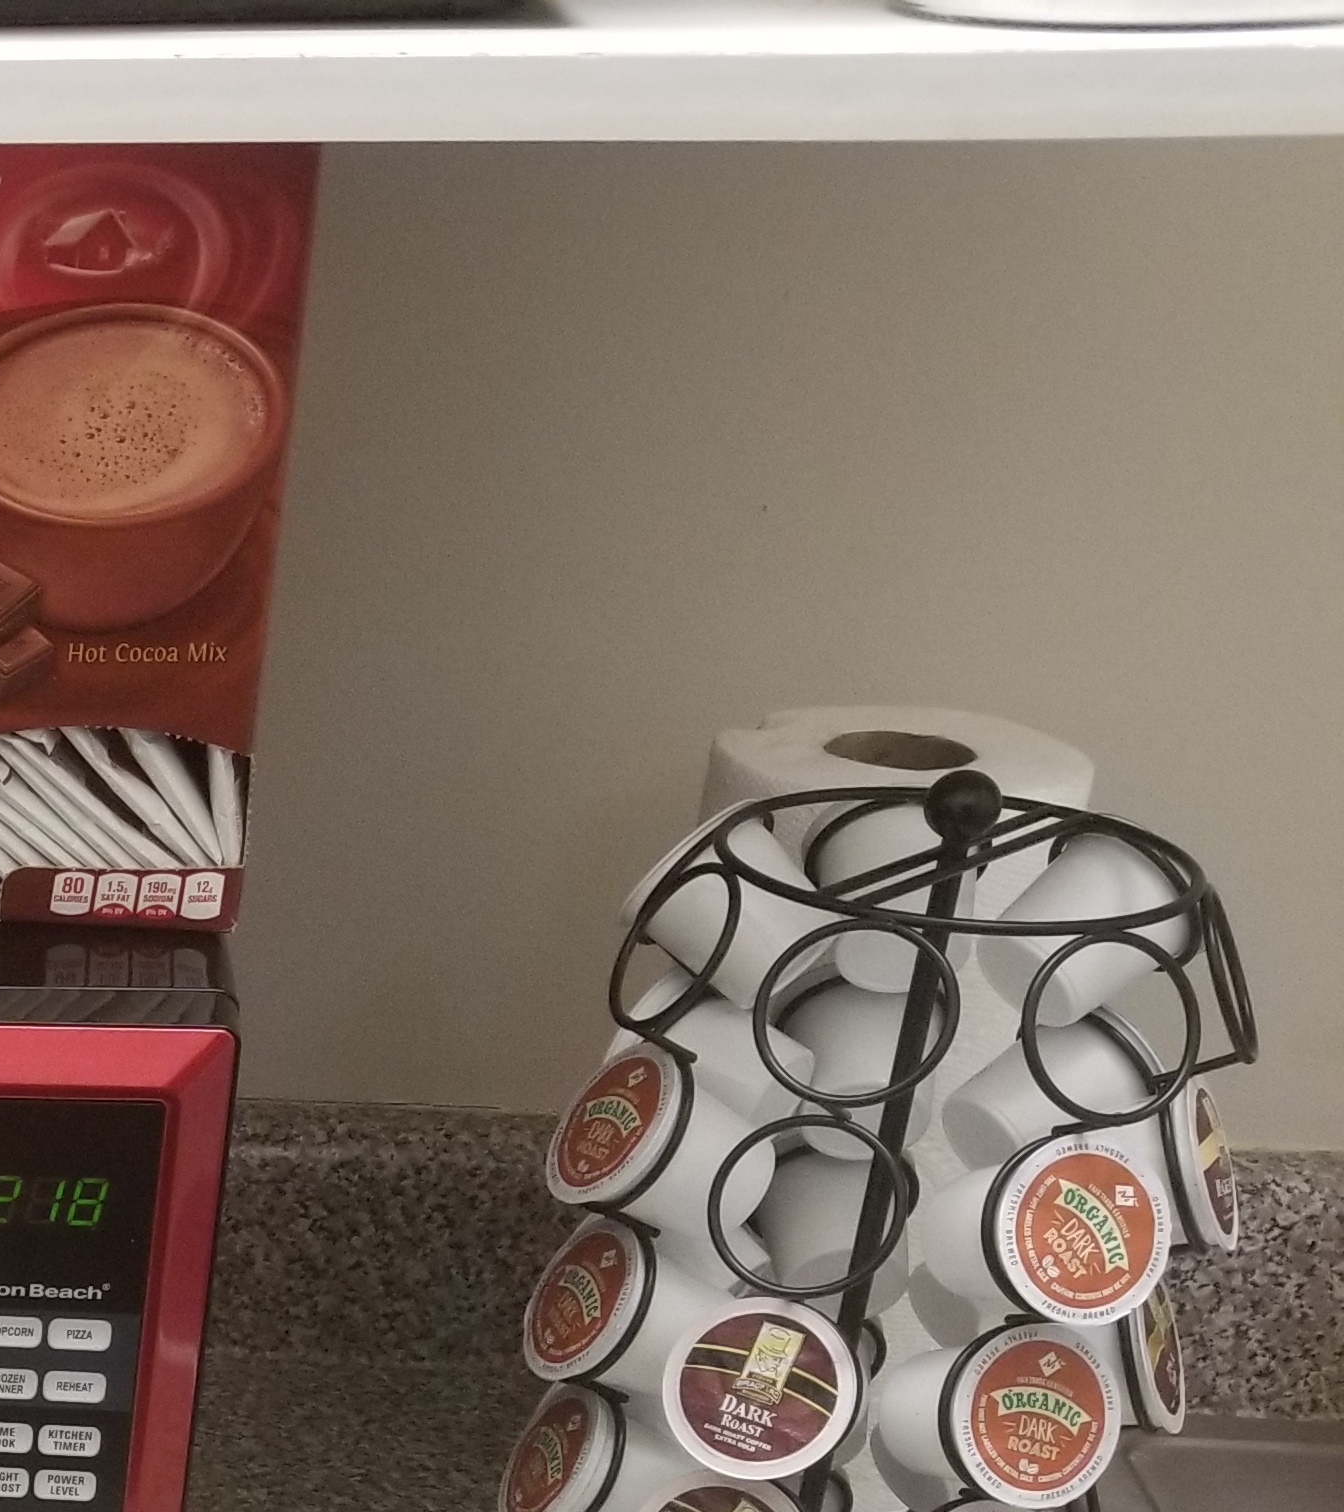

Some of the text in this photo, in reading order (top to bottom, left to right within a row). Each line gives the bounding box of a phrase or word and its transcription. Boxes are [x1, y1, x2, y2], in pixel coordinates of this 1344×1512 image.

[68, 642, 227, 665] Hot Cocoa Mix
[63, 877, 85, 894] 80
[100, 894, 131, 902] SAT FAT
[588, 1098, 641, 1134] ORGANIC
[1063, 1187, 1125, 1265] ORGANIC
[1061, 1217, 1101, 1264] DARK
[1043, 1227, 1087, 1279] ROAST
[29, 1284, 102, 1300] Beach
[66, 1329, 93, 1340] PIZZA
[56, 1381, 94, 1393] REHEAT
[719, 1393, 778, 1428] DARK
[1001, 1389, 1082, 1428] ORGANIC
[48, 1429, 93, 1441] KITCHEN
[720, 1413, 765, 1437] ROAST
[1019, 1415, 1059, 1444] DARK
[53, 1441, 86, 1452] TIMER
[1007, 1435, 1061, 1461] ROAST
[47, 1474, 85, 1485] POWER
[50, 1485, 80, 1496] LEVEL
